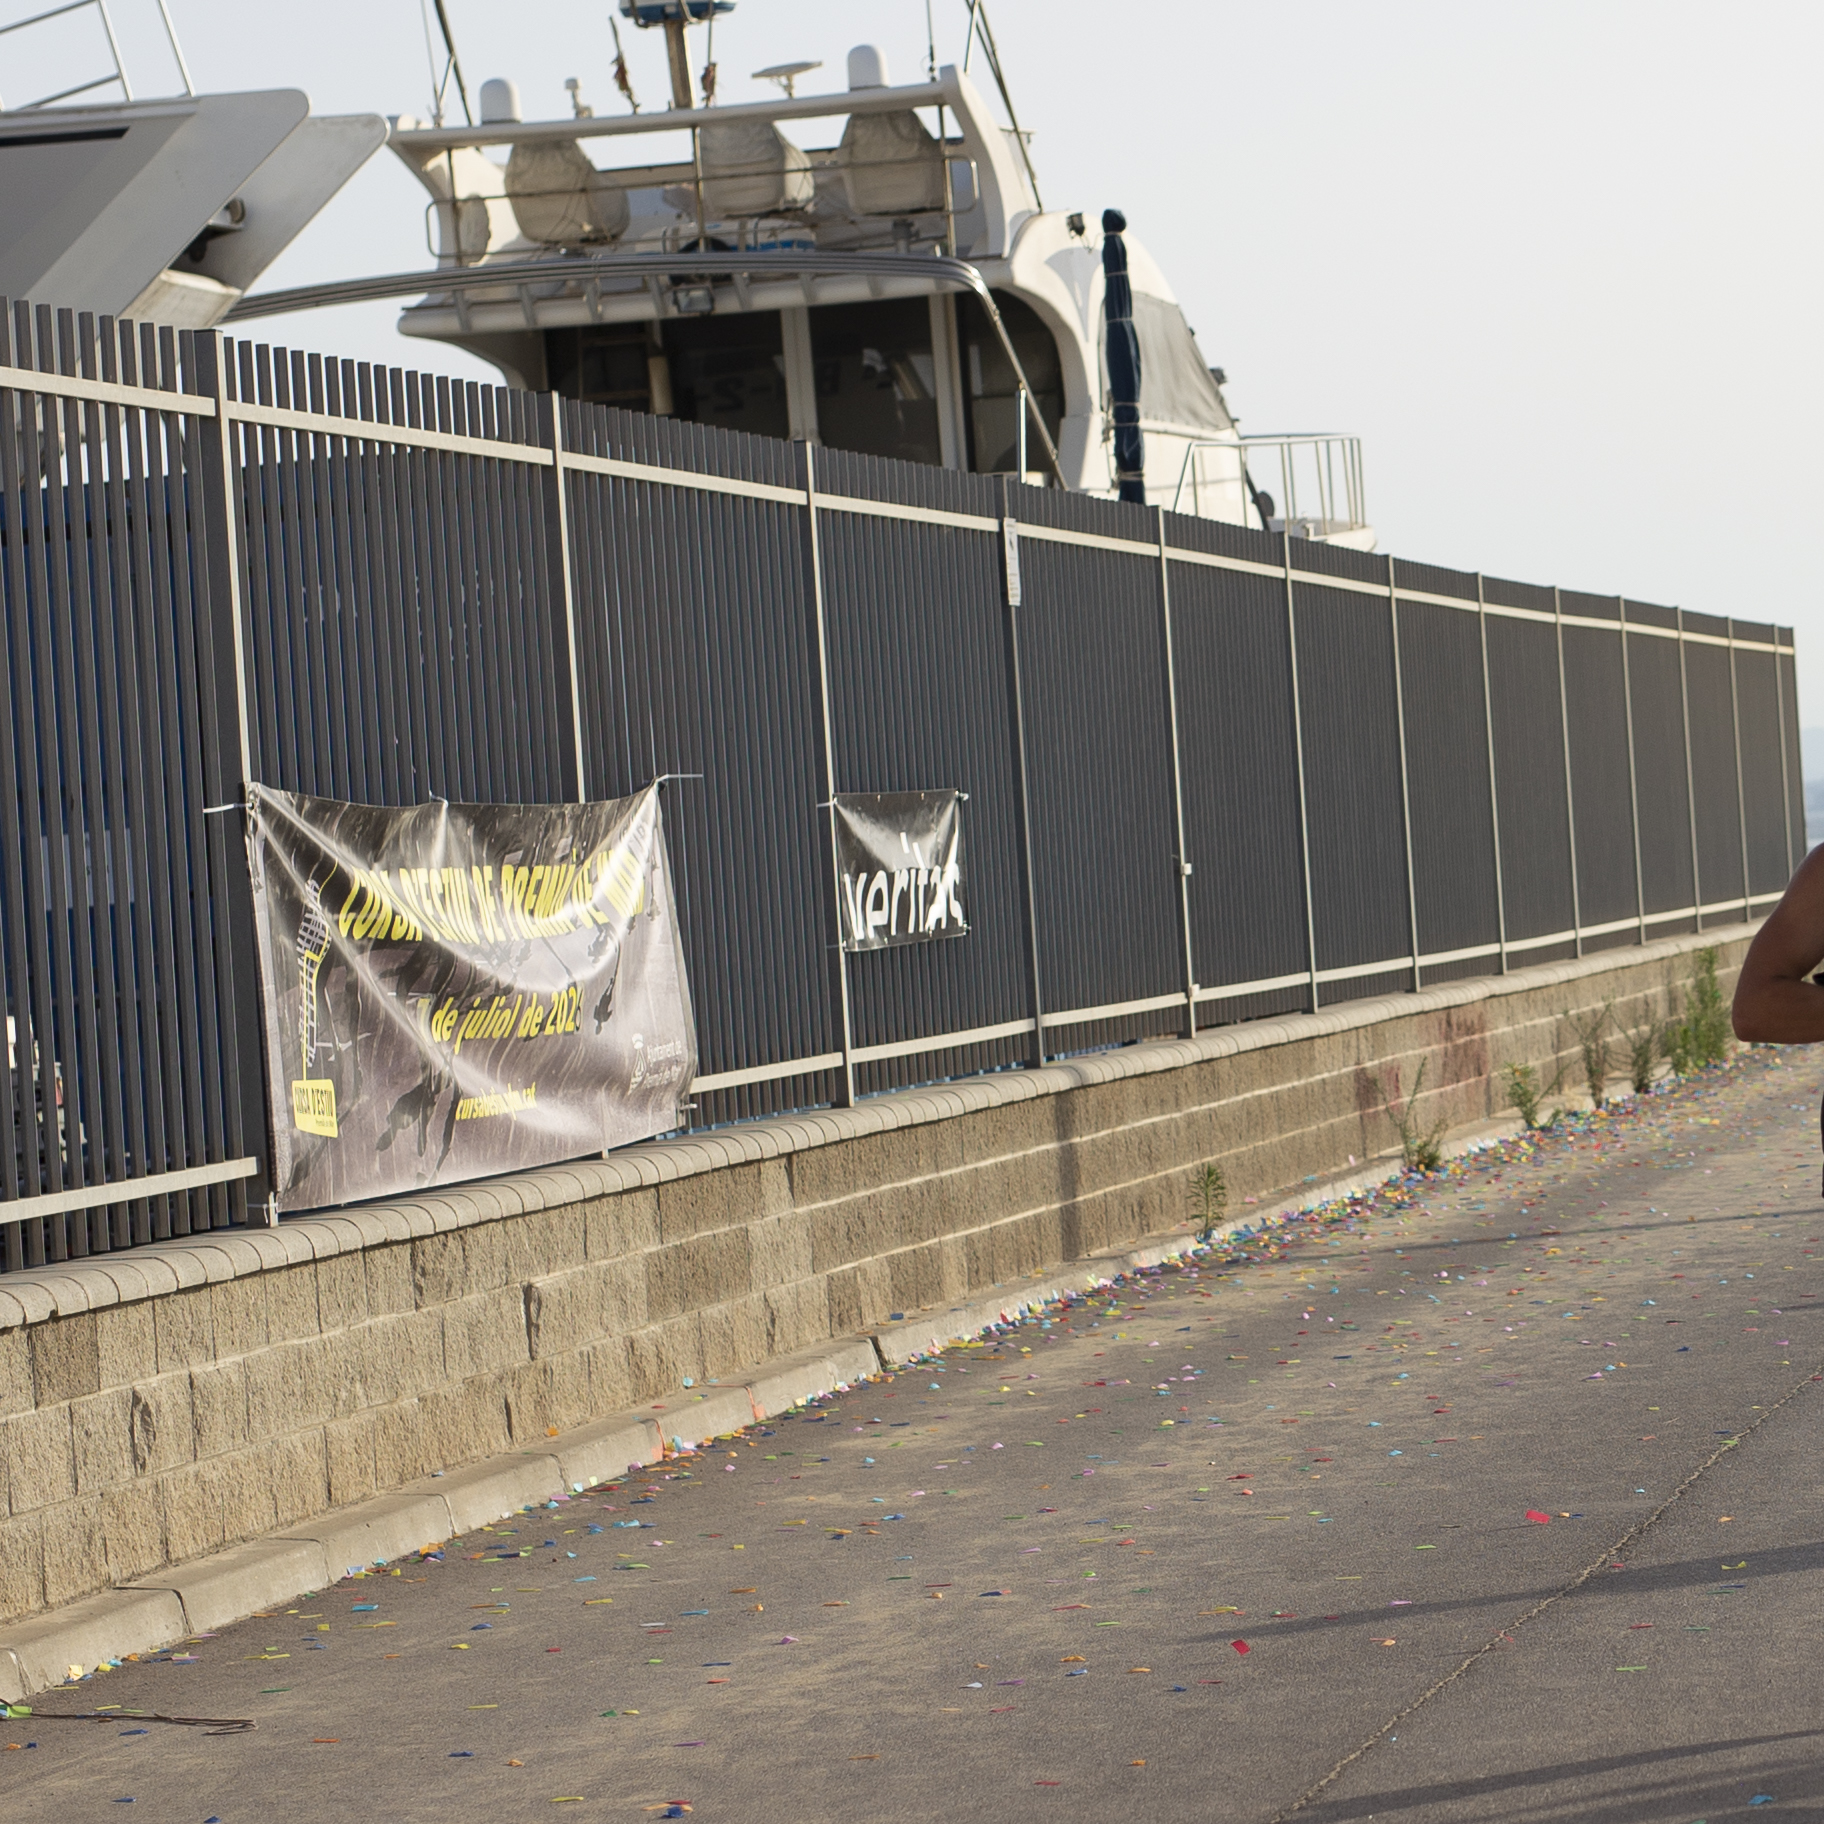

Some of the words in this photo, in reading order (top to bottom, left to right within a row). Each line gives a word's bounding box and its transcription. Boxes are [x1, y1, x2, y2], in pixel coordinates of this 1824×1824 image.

[844, 832, 963, 940] veritas
[432, 997, 458, 1043] de
[454, 995, 523, 1055] juliol
[517, 992, 544, 1038] de
